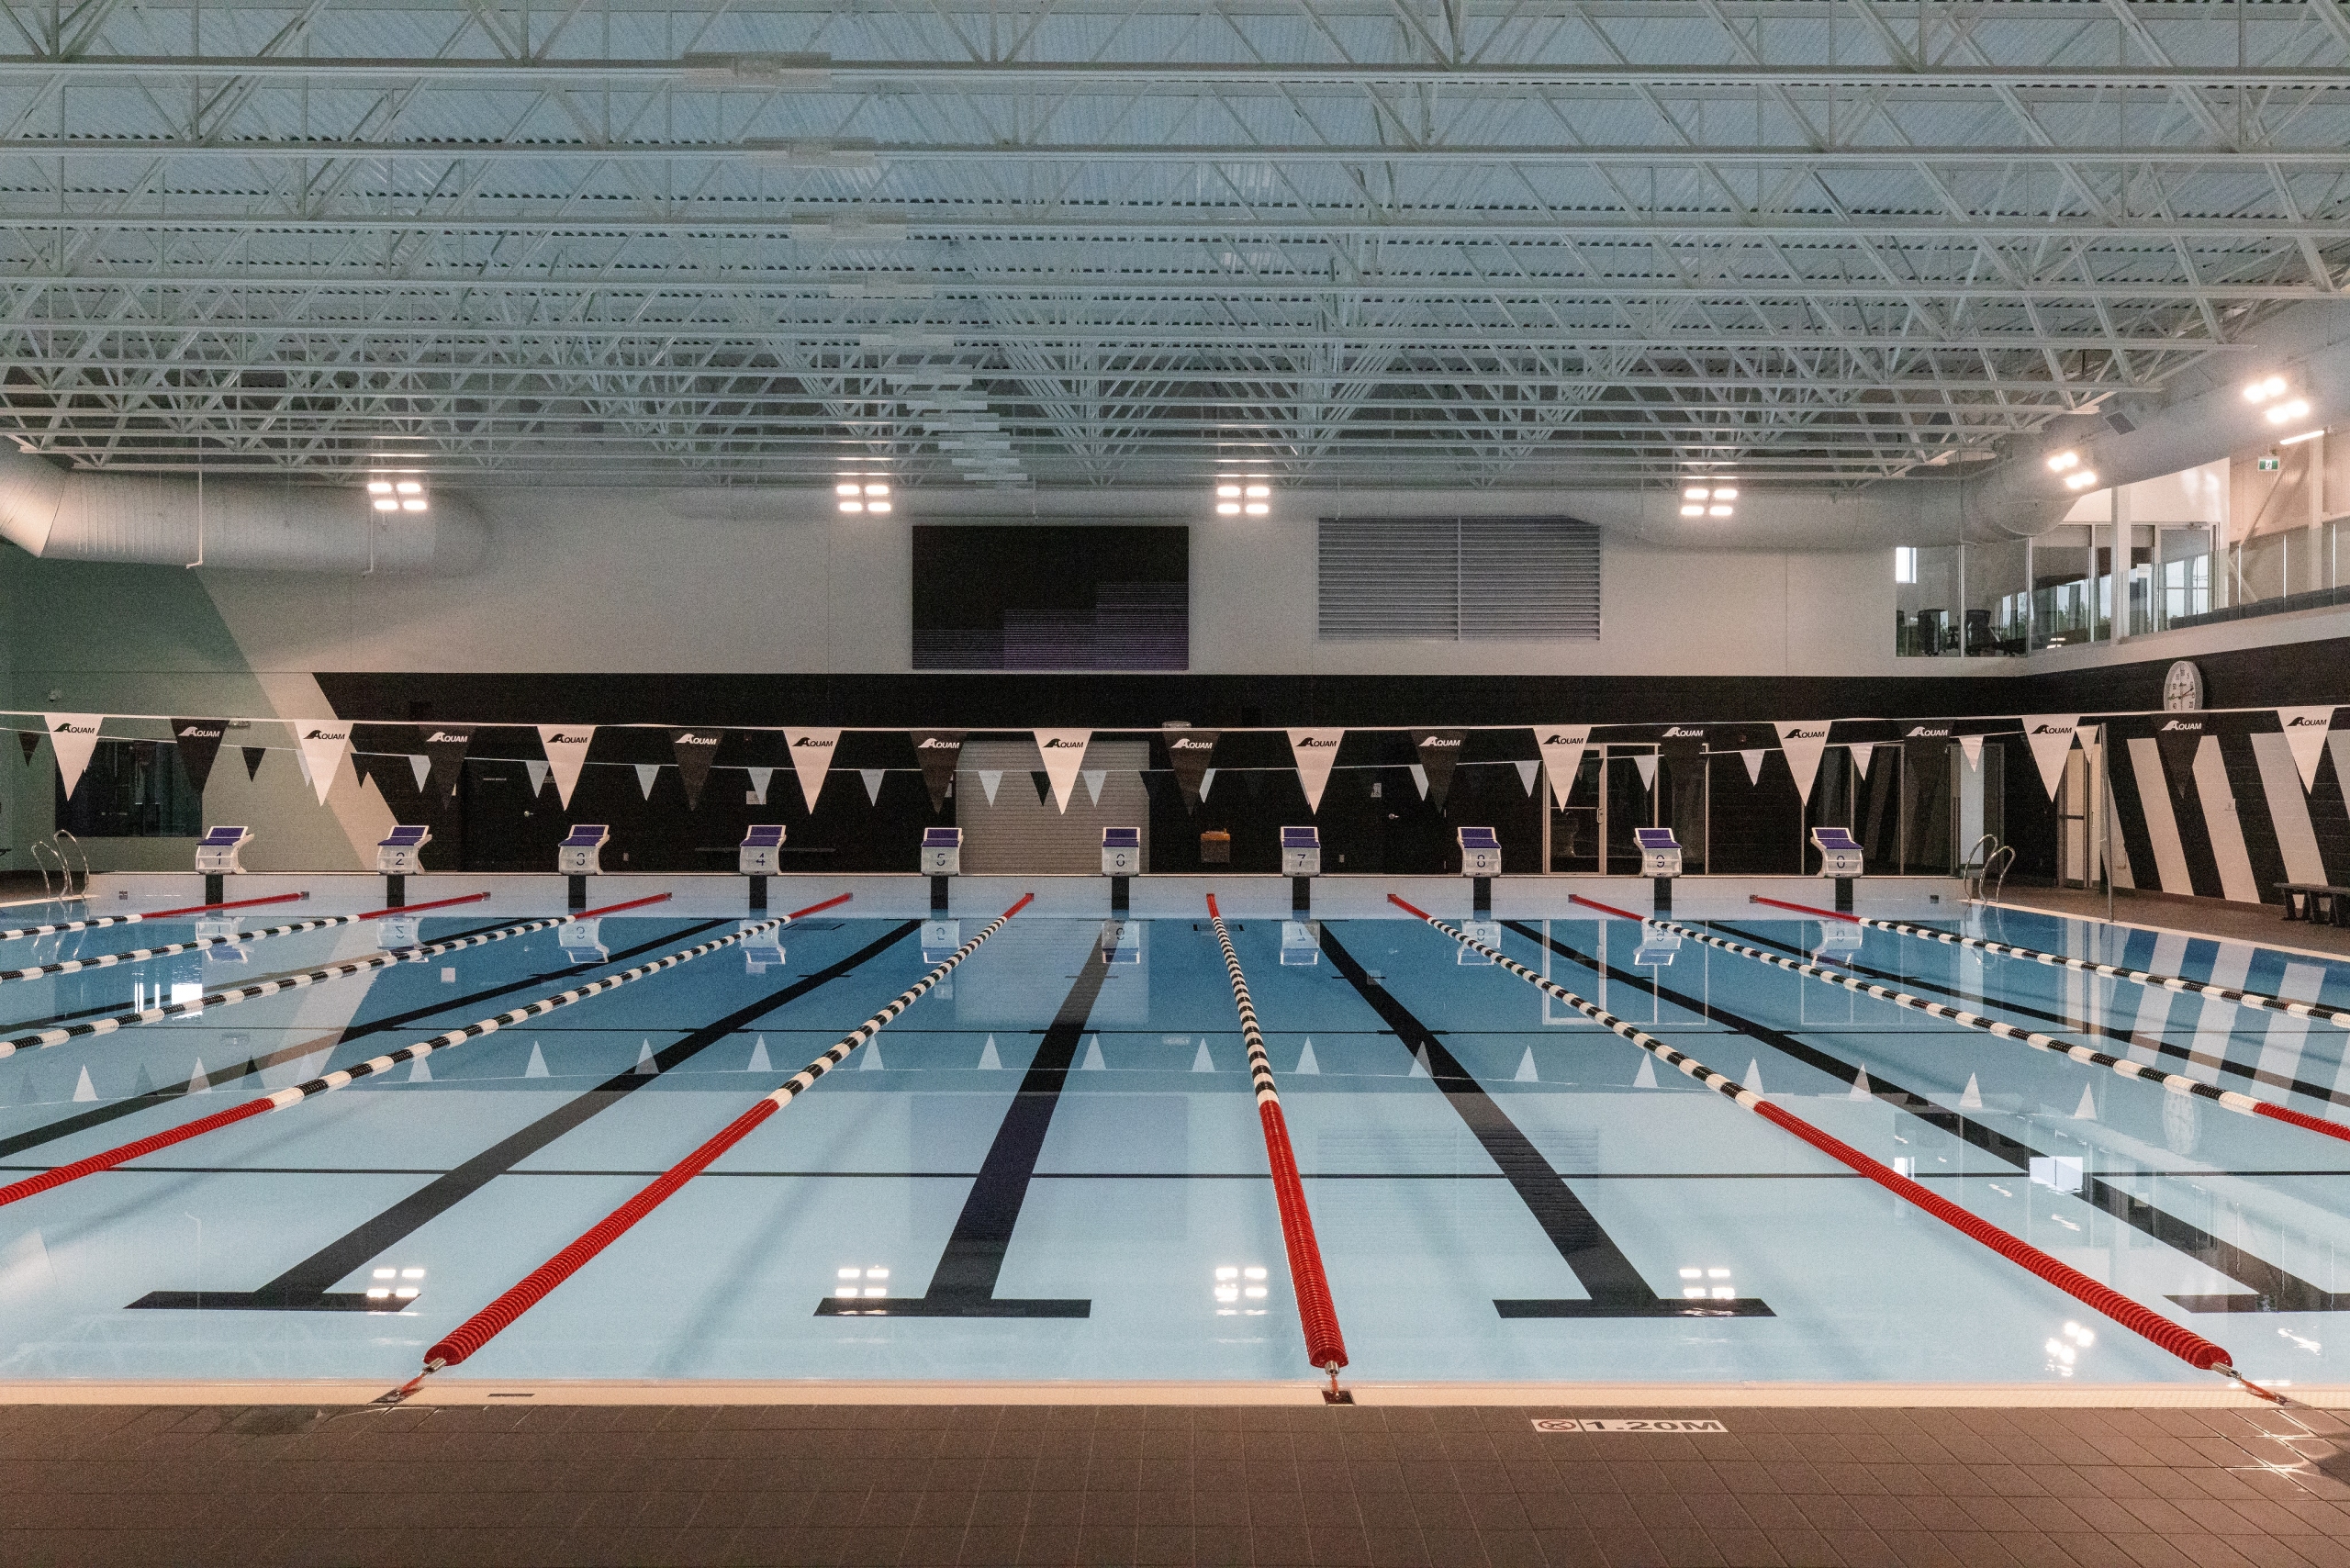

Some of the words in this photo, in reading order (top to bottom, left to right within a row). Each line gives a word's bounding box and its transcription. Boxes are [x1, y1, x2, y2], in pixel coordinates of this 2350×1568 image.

[2160, 720, 2202, 731] AQUAM
[2287, 716, 2327, 726] AQUAM
[52, 722, 95, 734] AQUAM
[178, 726, 220, 737] AQUAM
[1662, 726, 1704, 737] AQUAM
[1783, 728, 1825, 739] AQUAM
[1906, 726, 1948, 737] AQUAM
[2030, 724, 2072, 734] AQUAM
[303, 729, 345, 740] AQUAM
[426, 732, 468, 743] AQUAM
[545, 733, 588, 744] AQUAM
[675, 733, 717, 745] AQUAM
[1542, 734, 1583, 745] AQUAM
[792, 736, 834, 746] AQUAM
[918, 737, 960, 748] AQUAM
[1043, 738, 1084, 748] AQUAM
[1171, 738, 1214, 748] AQUAM
[1295, 736, 1337, 747] AQUAM
[1419, 735, 1460, 746] AQUAM
[216, 852, 222, 865] 1
[396, 852, 405, 865] 2
[576, 852, 585, 866] 3
[756, 852, 765, 866] 4
[936, 853, 946, 866] 5
[1297, 854, 1306, 867] 7
[1476, 855, 1485, 868] 8
[1656, 855, 1665, 868] 9
[1836, 855, 1845, 868] 0
[1585, 1421, 1721, 1430] 1.20M
